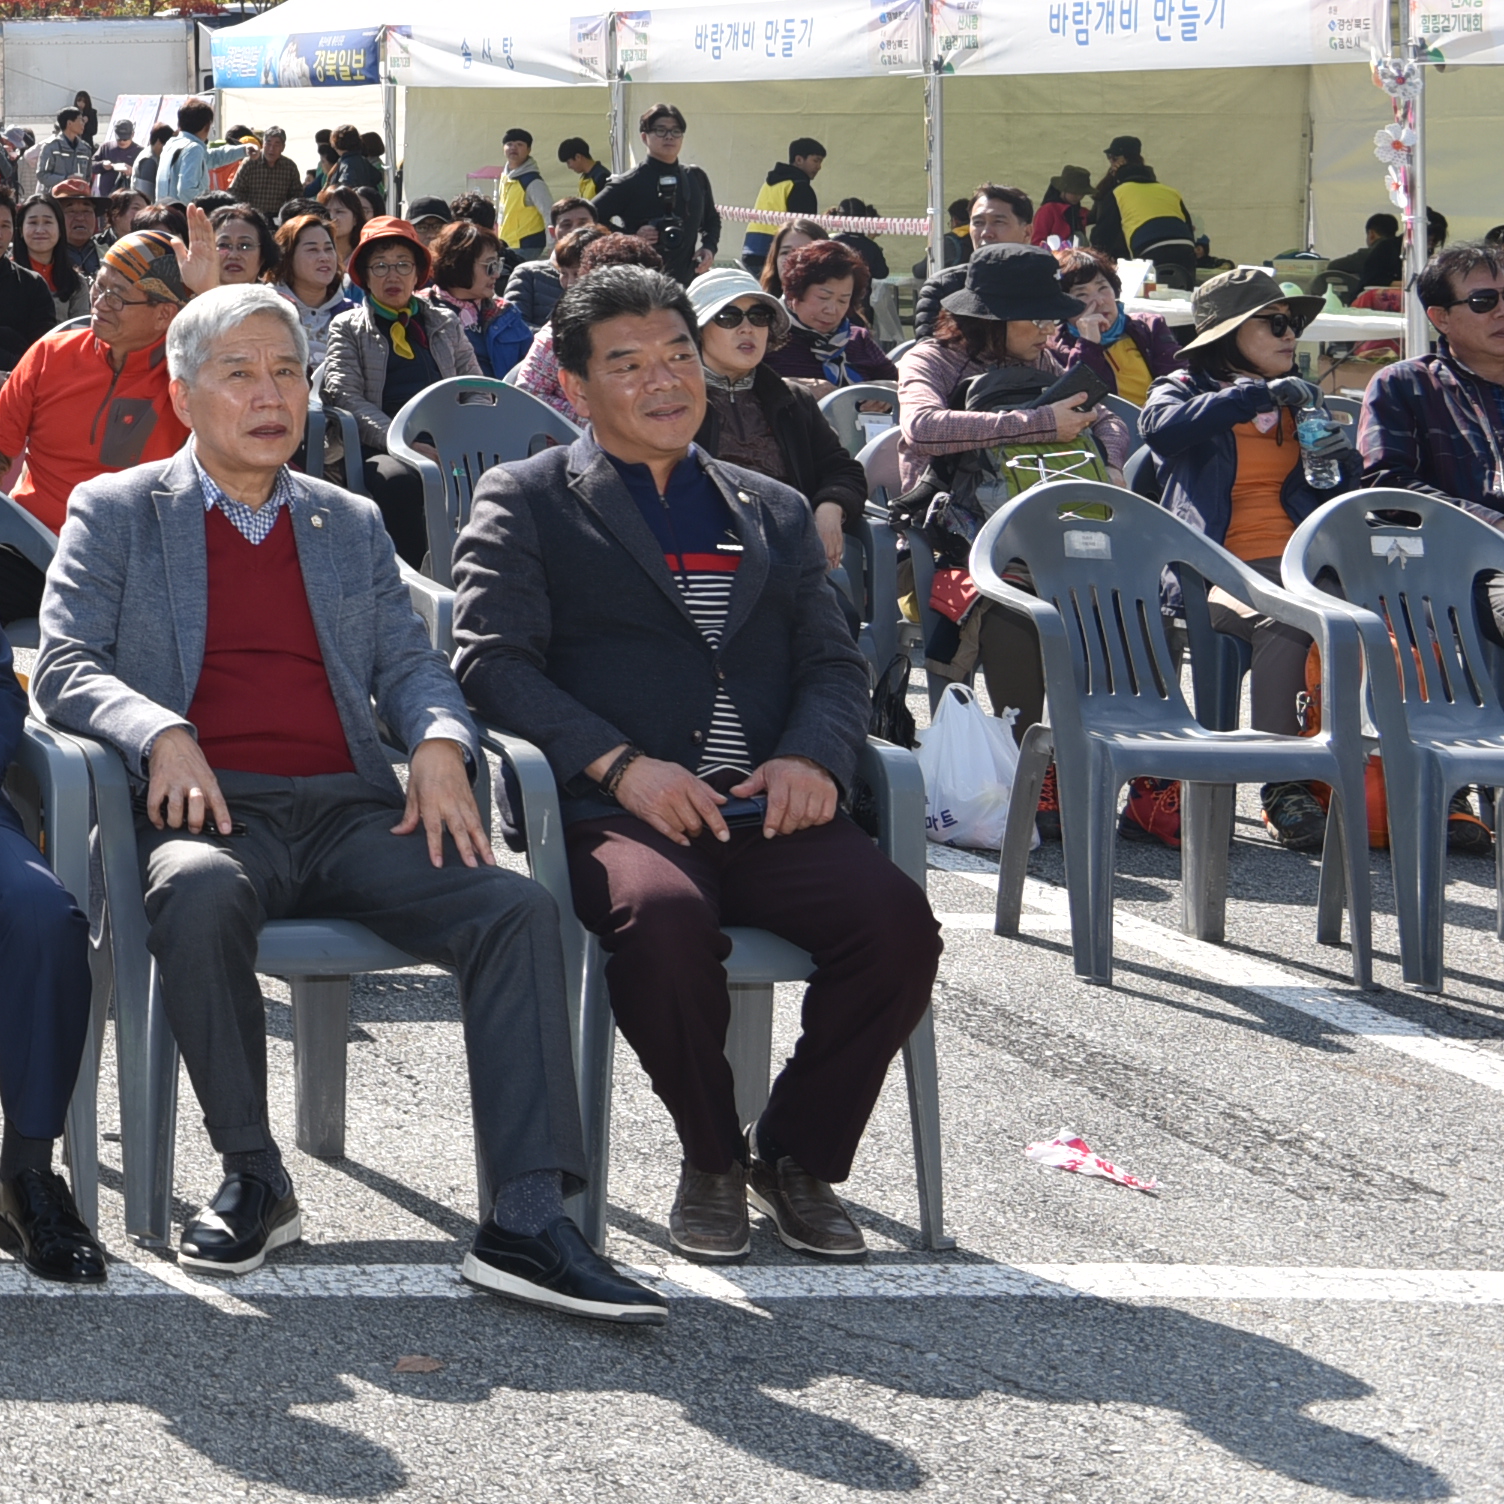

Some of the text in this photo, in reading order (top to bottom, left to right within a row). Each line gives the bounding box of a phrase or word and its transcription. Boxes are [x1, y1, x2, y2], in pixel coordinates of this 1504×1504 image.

[1336, 18, 1371, 31] 경상북도
[1420, 12, 1484, 34] 힐링걷기대회
[694, 17, 814, 60] 바람개비 만들기
[1337, 37, 1361, 49] 경산시
[312, 48, 366, 83] 경북일보
